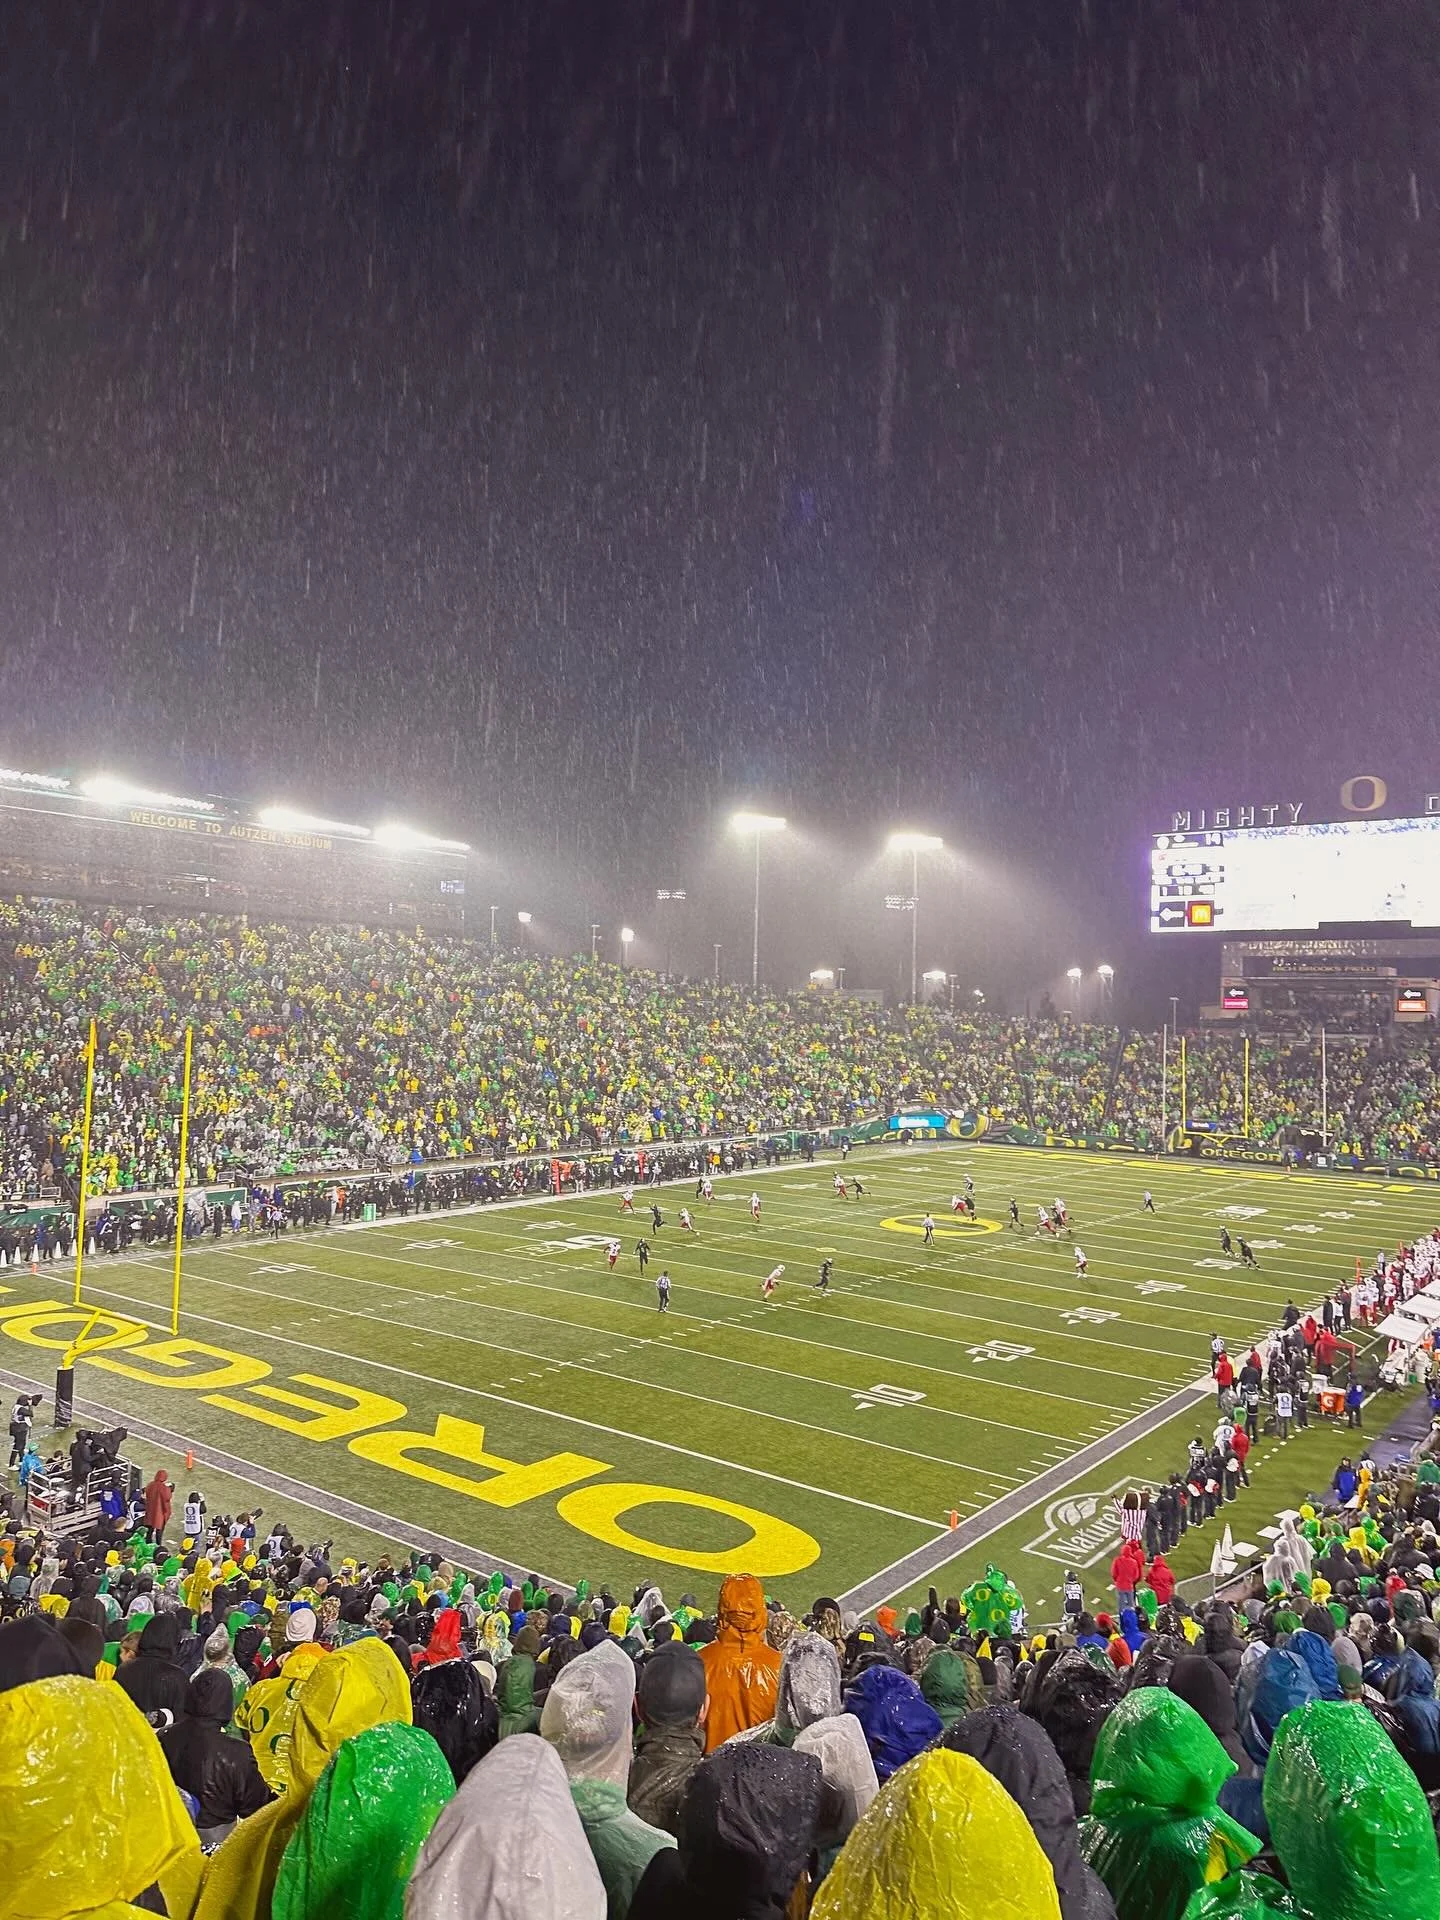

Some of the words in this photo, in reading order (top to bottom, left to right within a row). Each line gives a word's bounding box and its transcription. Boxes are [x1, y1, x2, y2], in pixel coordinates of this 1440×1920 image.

[1341, 776, 1387, 812] O
[1172, 803, 1303, 831] MIGHTY
[130, 811, 197, 831] WELCOME
[204, 821, 222, 833] TO
[229, 826, 276, 842] AUTZEN
[284, 833, 332, 850] STADIUM
[1058, 1306, 1121, 1324] 30
[965, 1339, 1036, 1362] 20
[851, 1383, 927, 1407] 10
